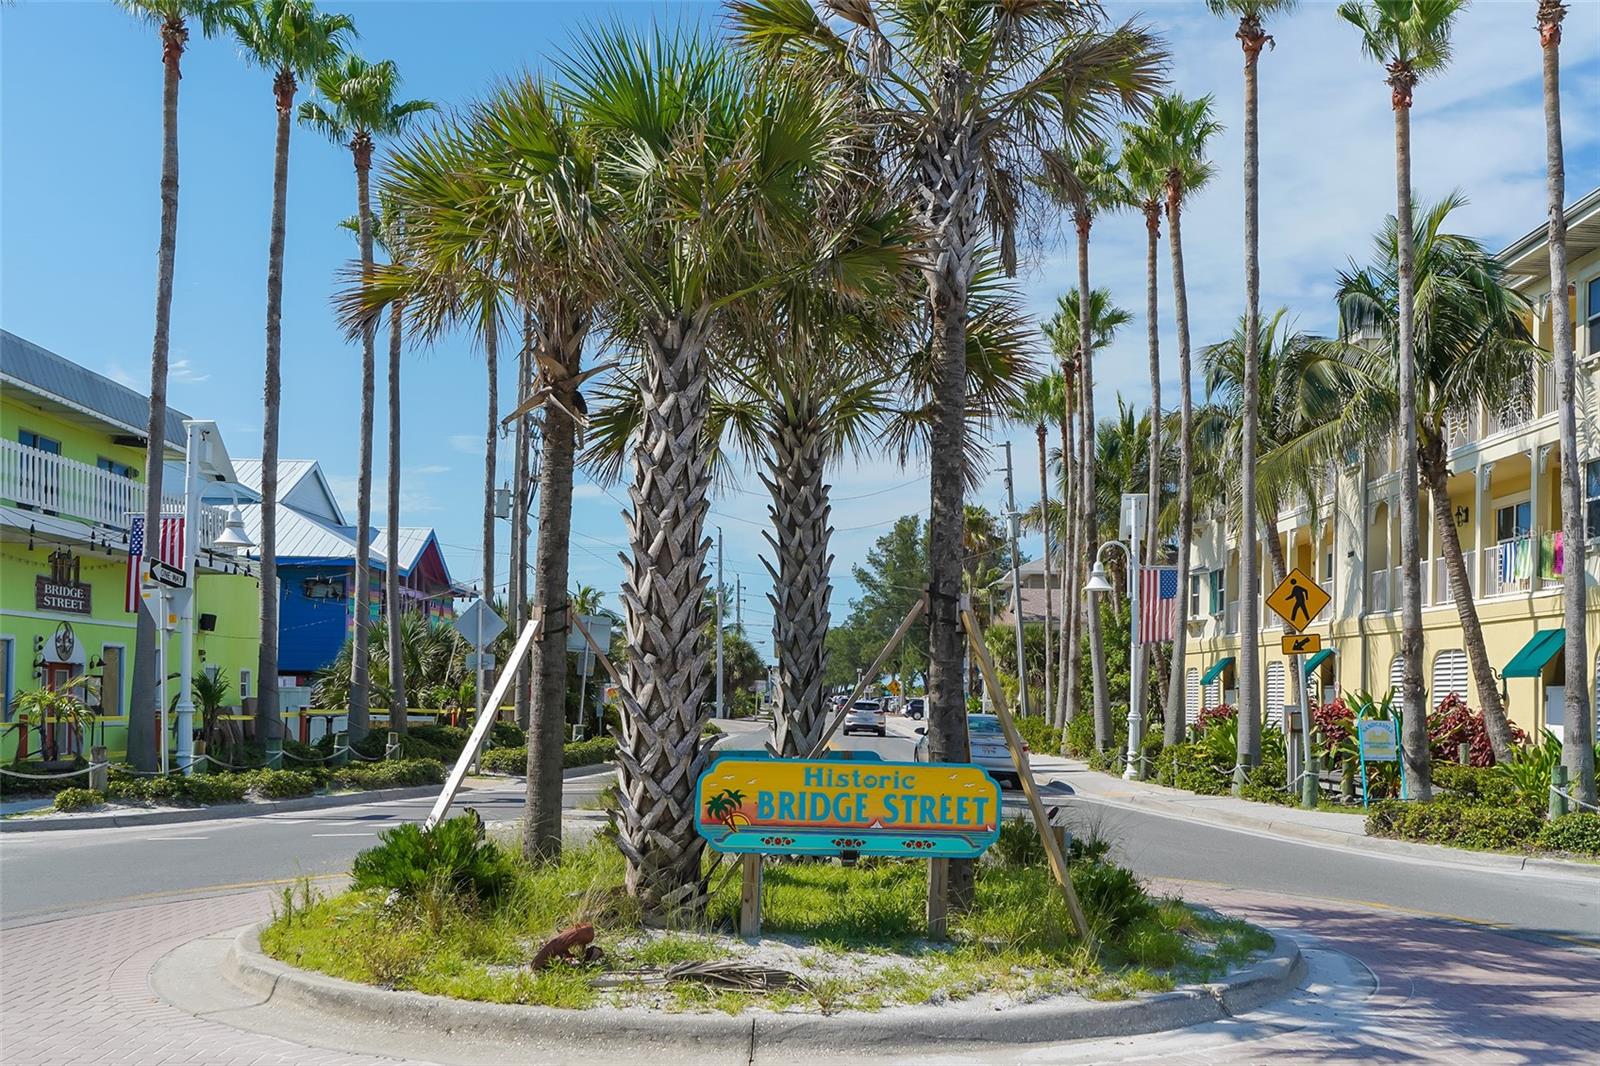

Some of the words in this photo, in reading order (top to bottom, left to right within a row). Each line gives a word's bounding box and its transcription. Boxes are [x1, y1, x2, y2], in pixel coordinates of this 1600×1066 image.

[161, 569, 172, 580] ONE
[172, 573, 184, 586] WAY
[44, 584, 84, 599] BRIDGE
[43, 595, 85, 610] STREET
[804, 767, 916, 790] Historic
[756, 790, 870, 823] BRIDGE
[882, 793, 989, 825] STREET
